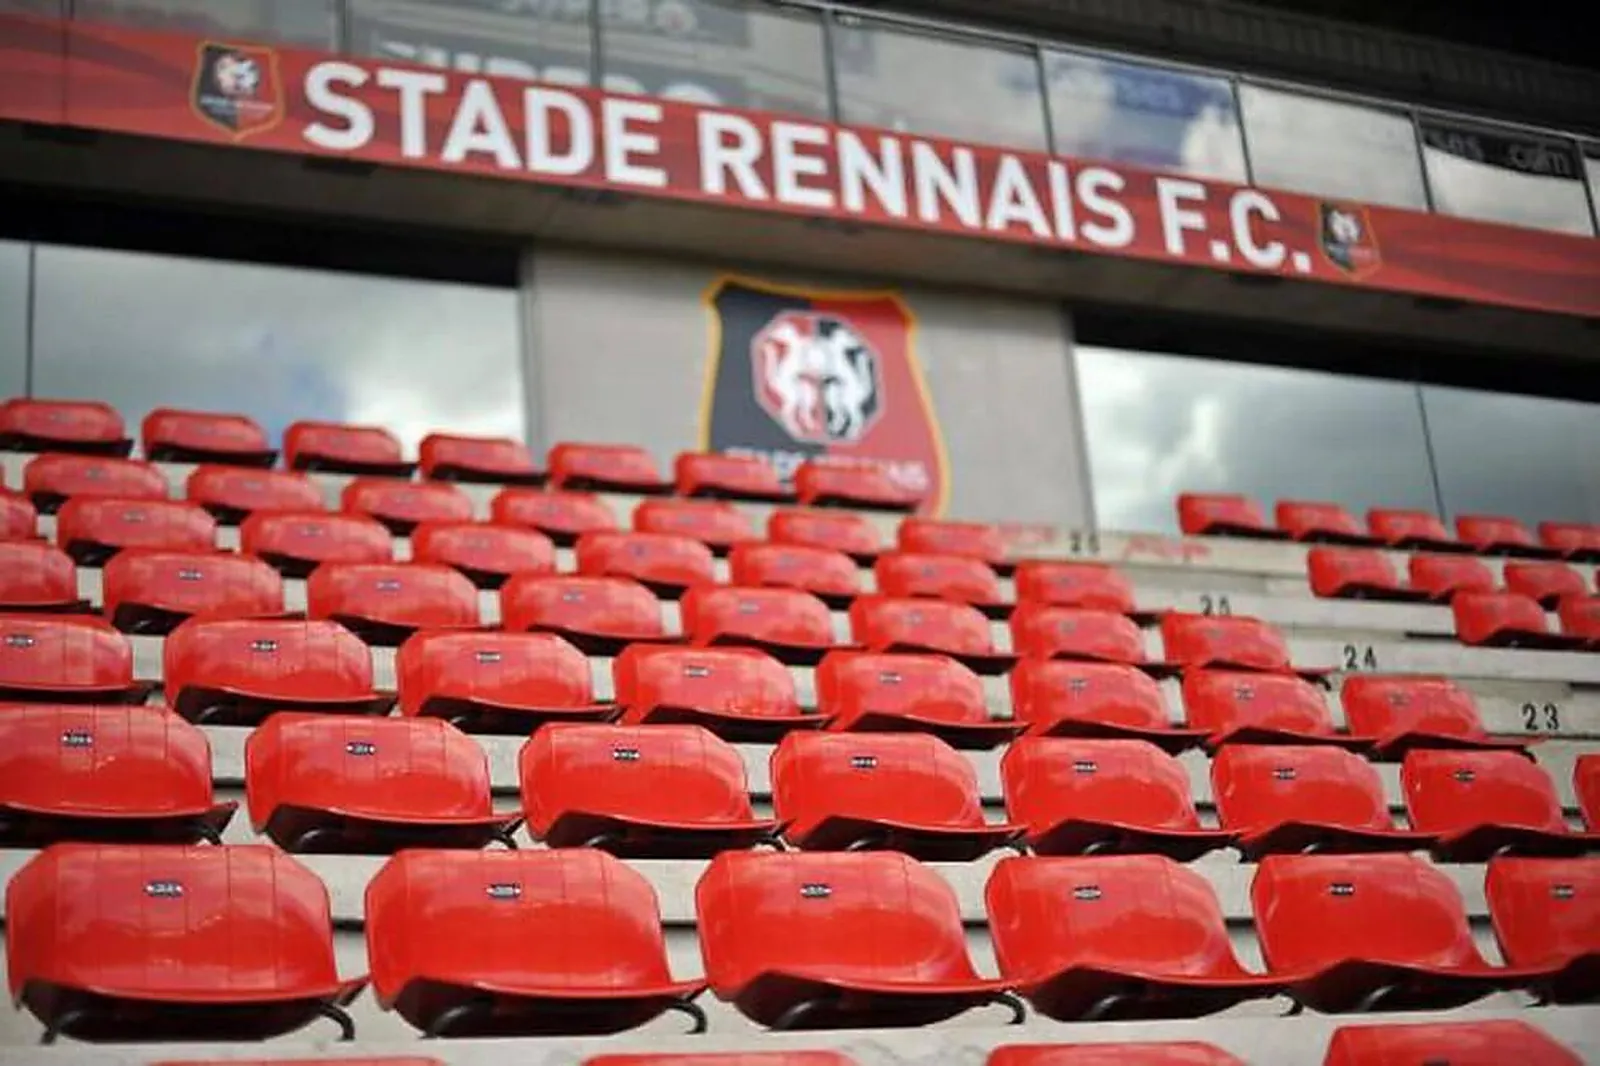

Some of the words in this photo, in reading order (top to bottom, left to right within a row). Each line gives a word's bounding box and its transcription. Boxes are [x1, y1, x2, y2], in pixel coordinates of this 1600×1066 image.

[302, 60, 669, 189] STADE
[696, 110, 1136, 250] RENNAIS
[1155, 176, 1312, 275] F.C.
[1343, 643, 1378, 670] 24
[1521, 702, 1559, 730] 23
